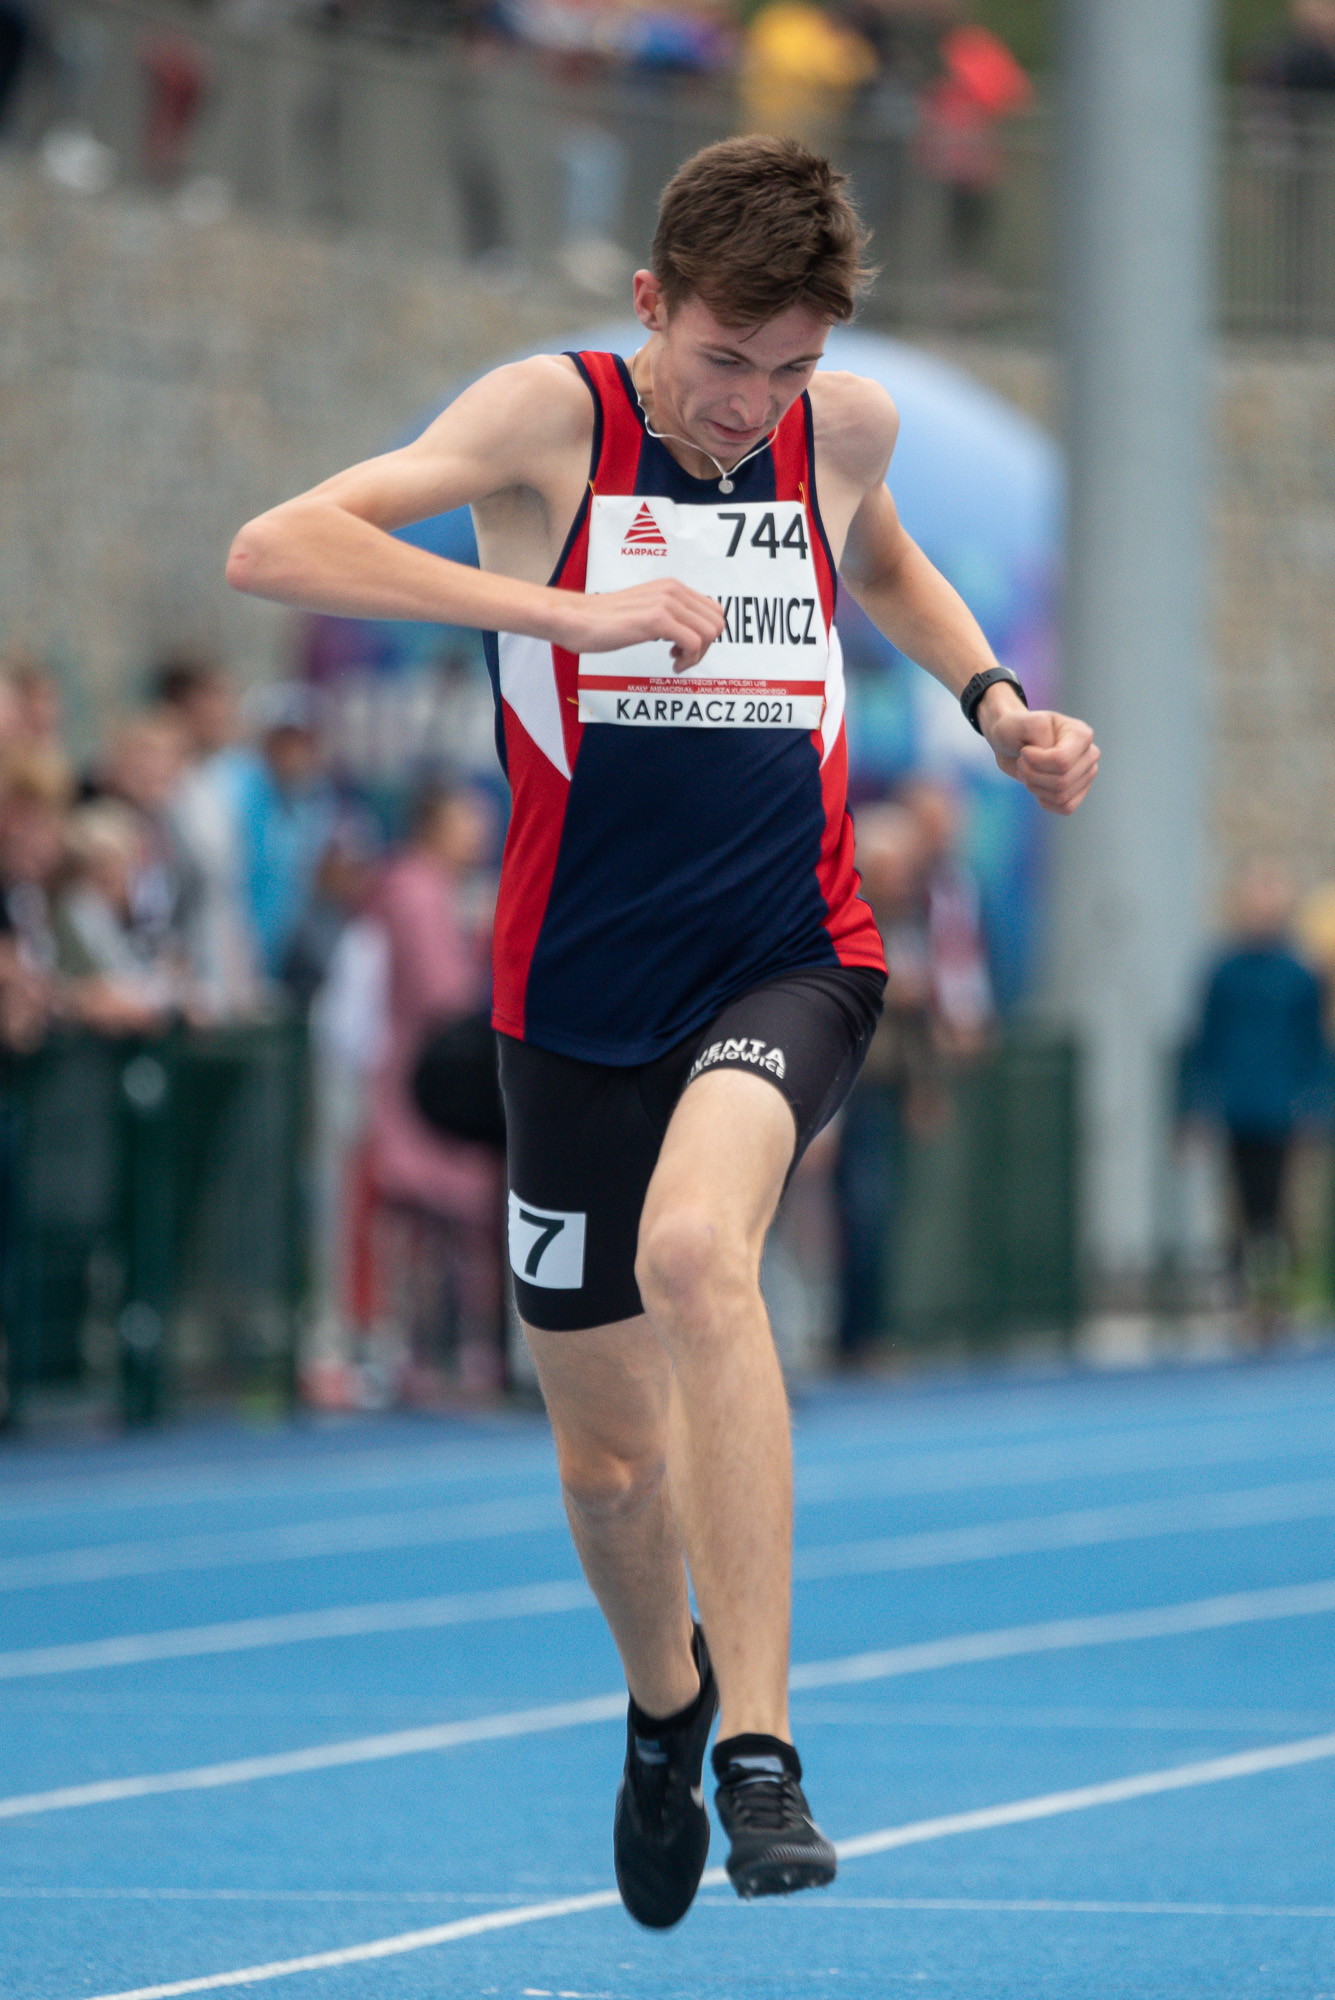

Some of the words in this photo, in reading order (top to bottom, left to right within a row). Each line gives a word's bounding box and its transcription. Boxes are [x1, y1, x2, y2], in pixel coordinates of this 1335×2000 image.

[716, 512, 808, 560] 744
[620, 547, 668, 557] KARPACZ
[649, 677, 671, 685] PZLA
[672, 678, 727, 686] MISTRZOSTWA
[696, 686, 730, 694] JANUSZA
[616, 698, 736, 722] KARPACZ
[742, 701, 793, 723] 2021
[519, 1207, 565, 1279] 7
